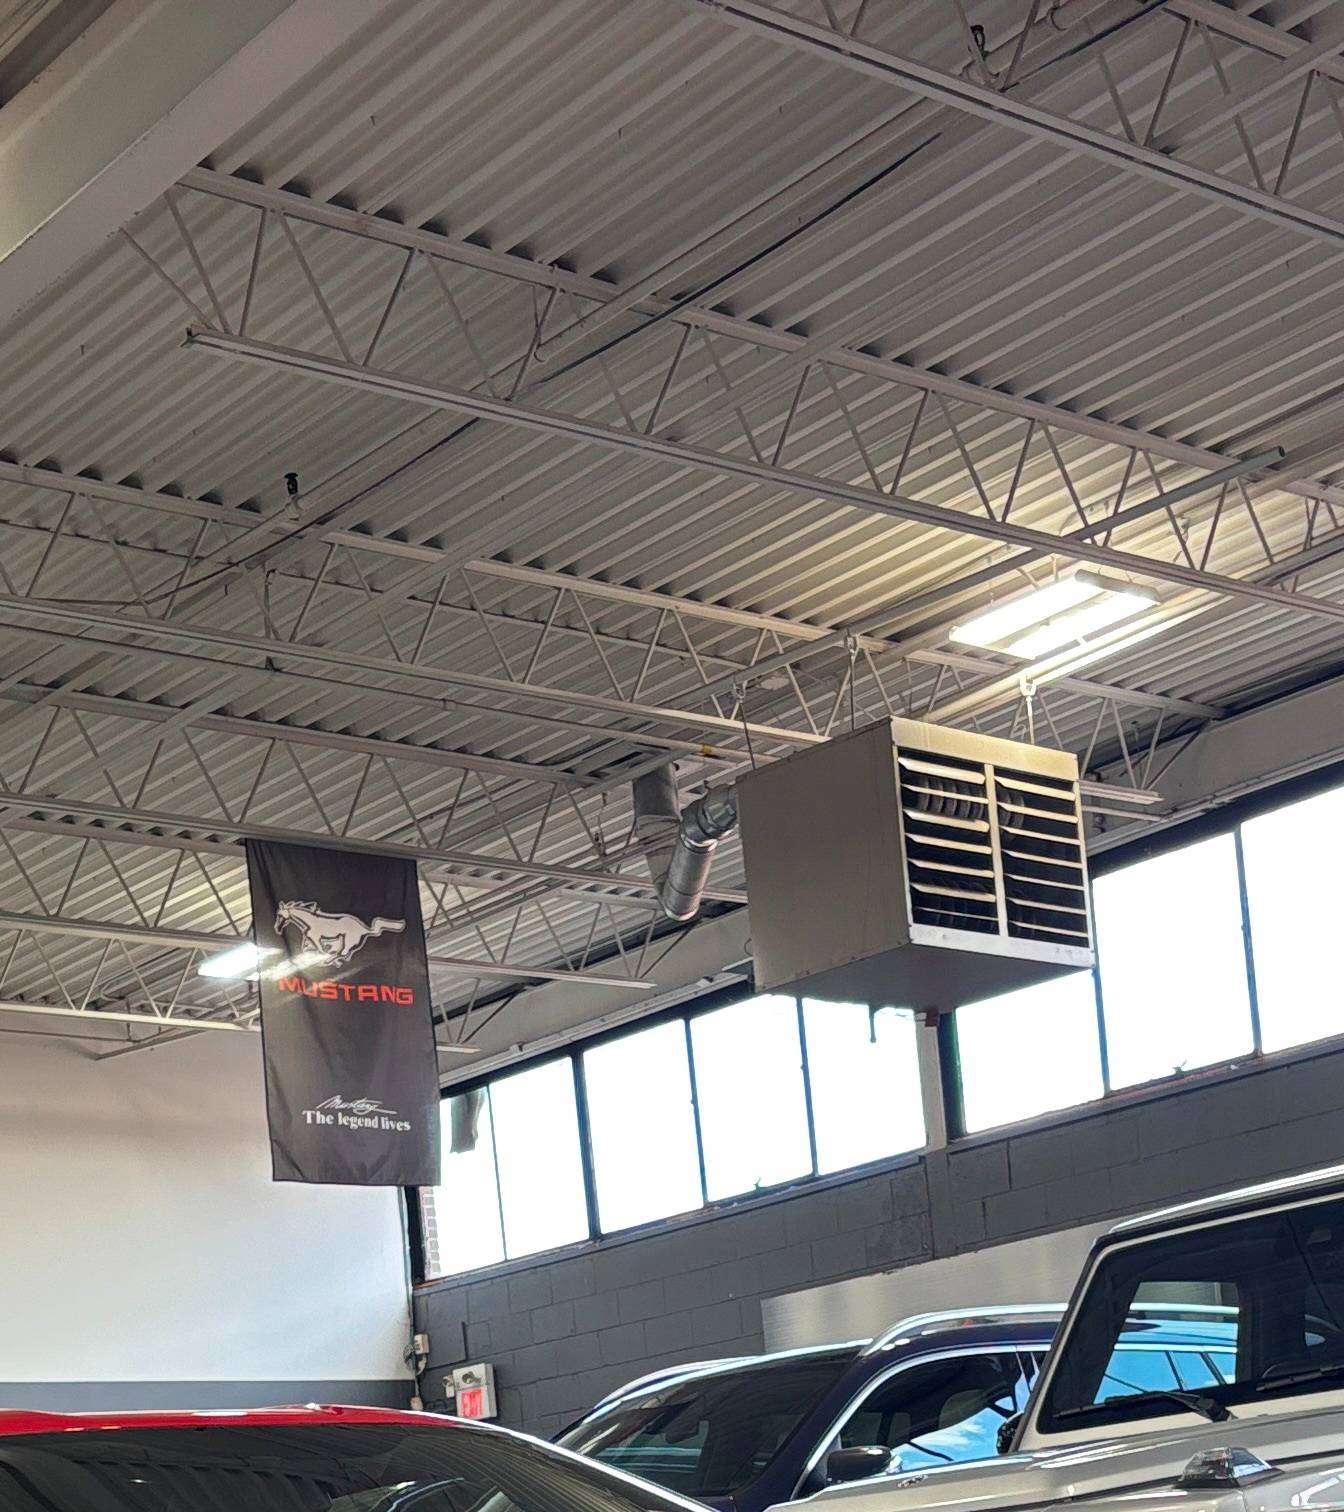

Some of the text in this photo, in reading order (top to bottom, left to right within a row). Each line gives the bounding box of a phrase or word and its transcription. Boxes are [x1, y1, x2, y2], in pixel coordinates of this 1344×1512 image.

[278, 975, 414, 1006] MUSTANG
[316, 1095, 397, 1115] Mustang
[302, 1110, 411, 1131] The legend lives
